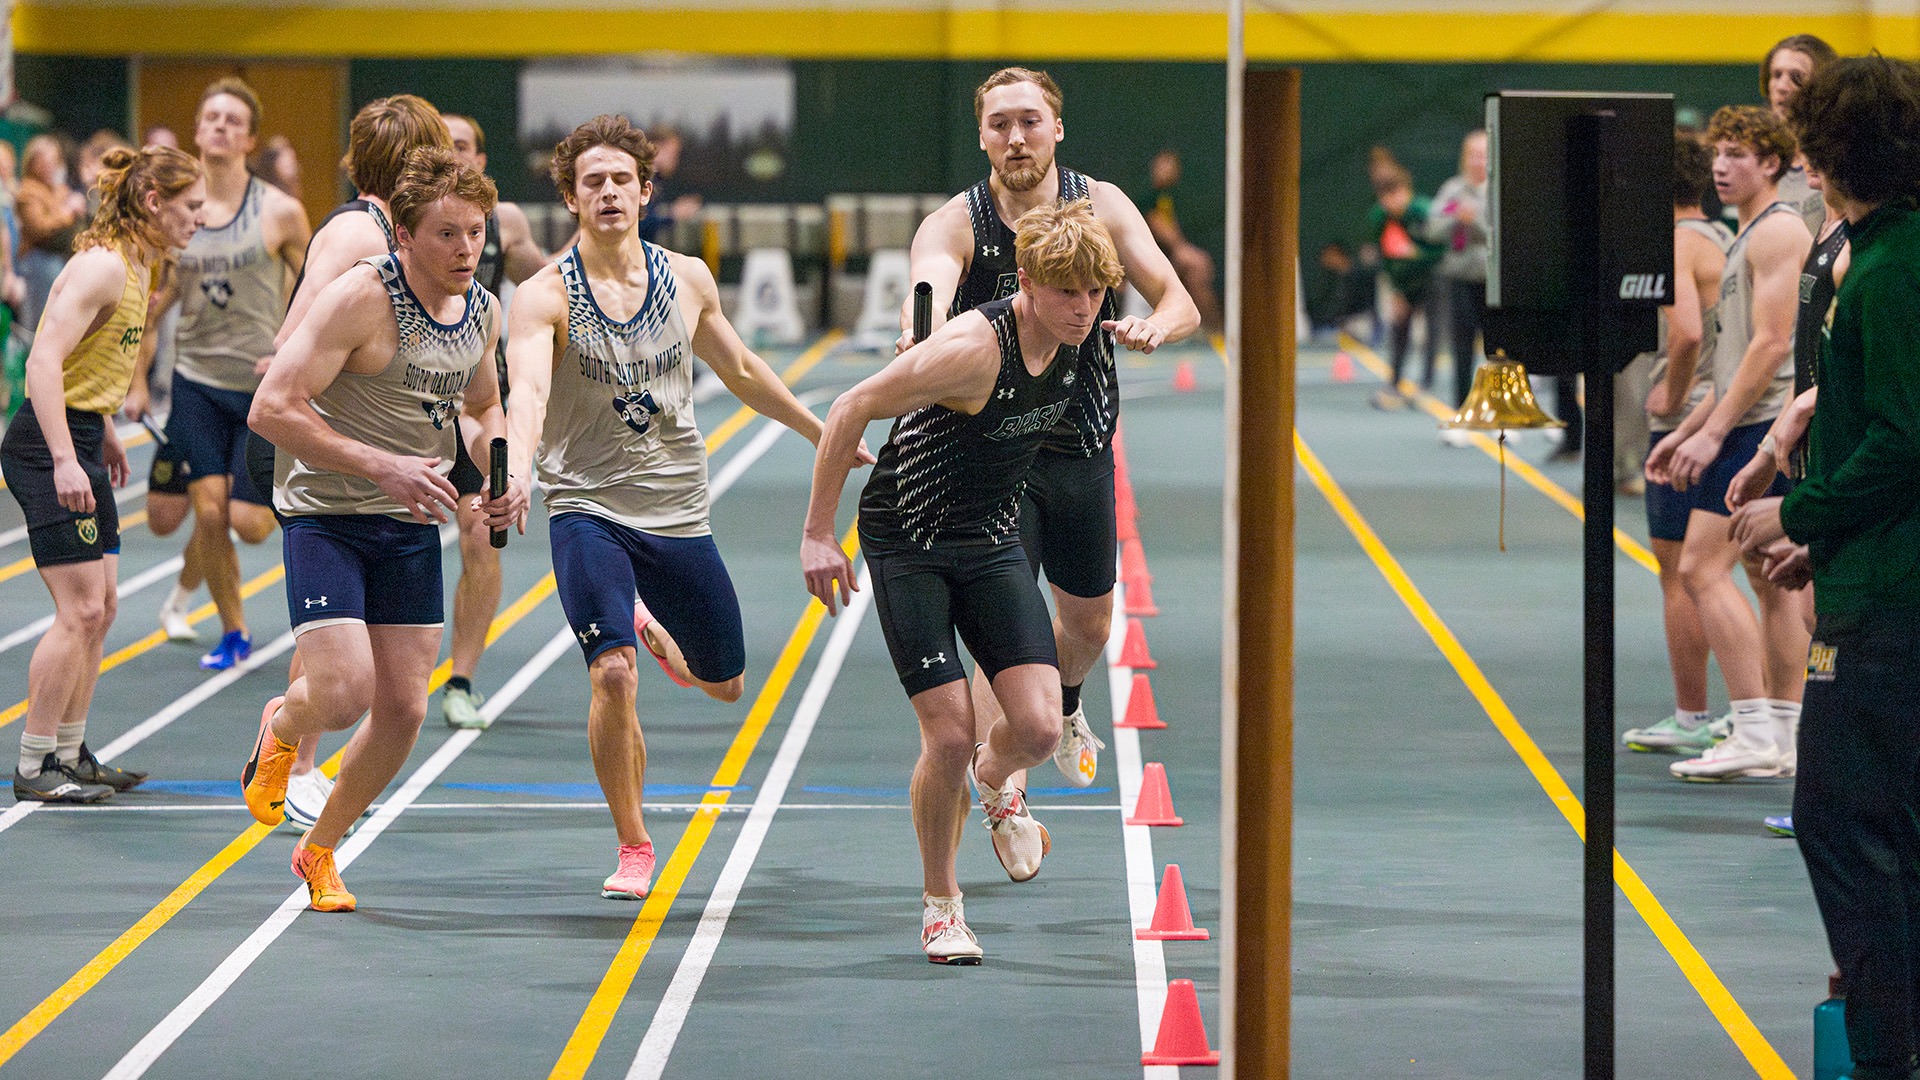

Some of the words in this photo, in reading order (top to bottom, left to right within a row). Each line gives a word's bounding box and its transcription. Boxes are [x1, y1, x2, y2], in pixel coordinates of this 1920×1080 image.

[1619, 273, 1666, 300] GILL
[403, 363, 431, 393] SOUTH
[430, 370, 465, 396] DAKOTA
[579, 353, 611, 385] SOUTH
[616, 359, 650, 387] DAKOTA
[655, 341, 682, 379] MINES
